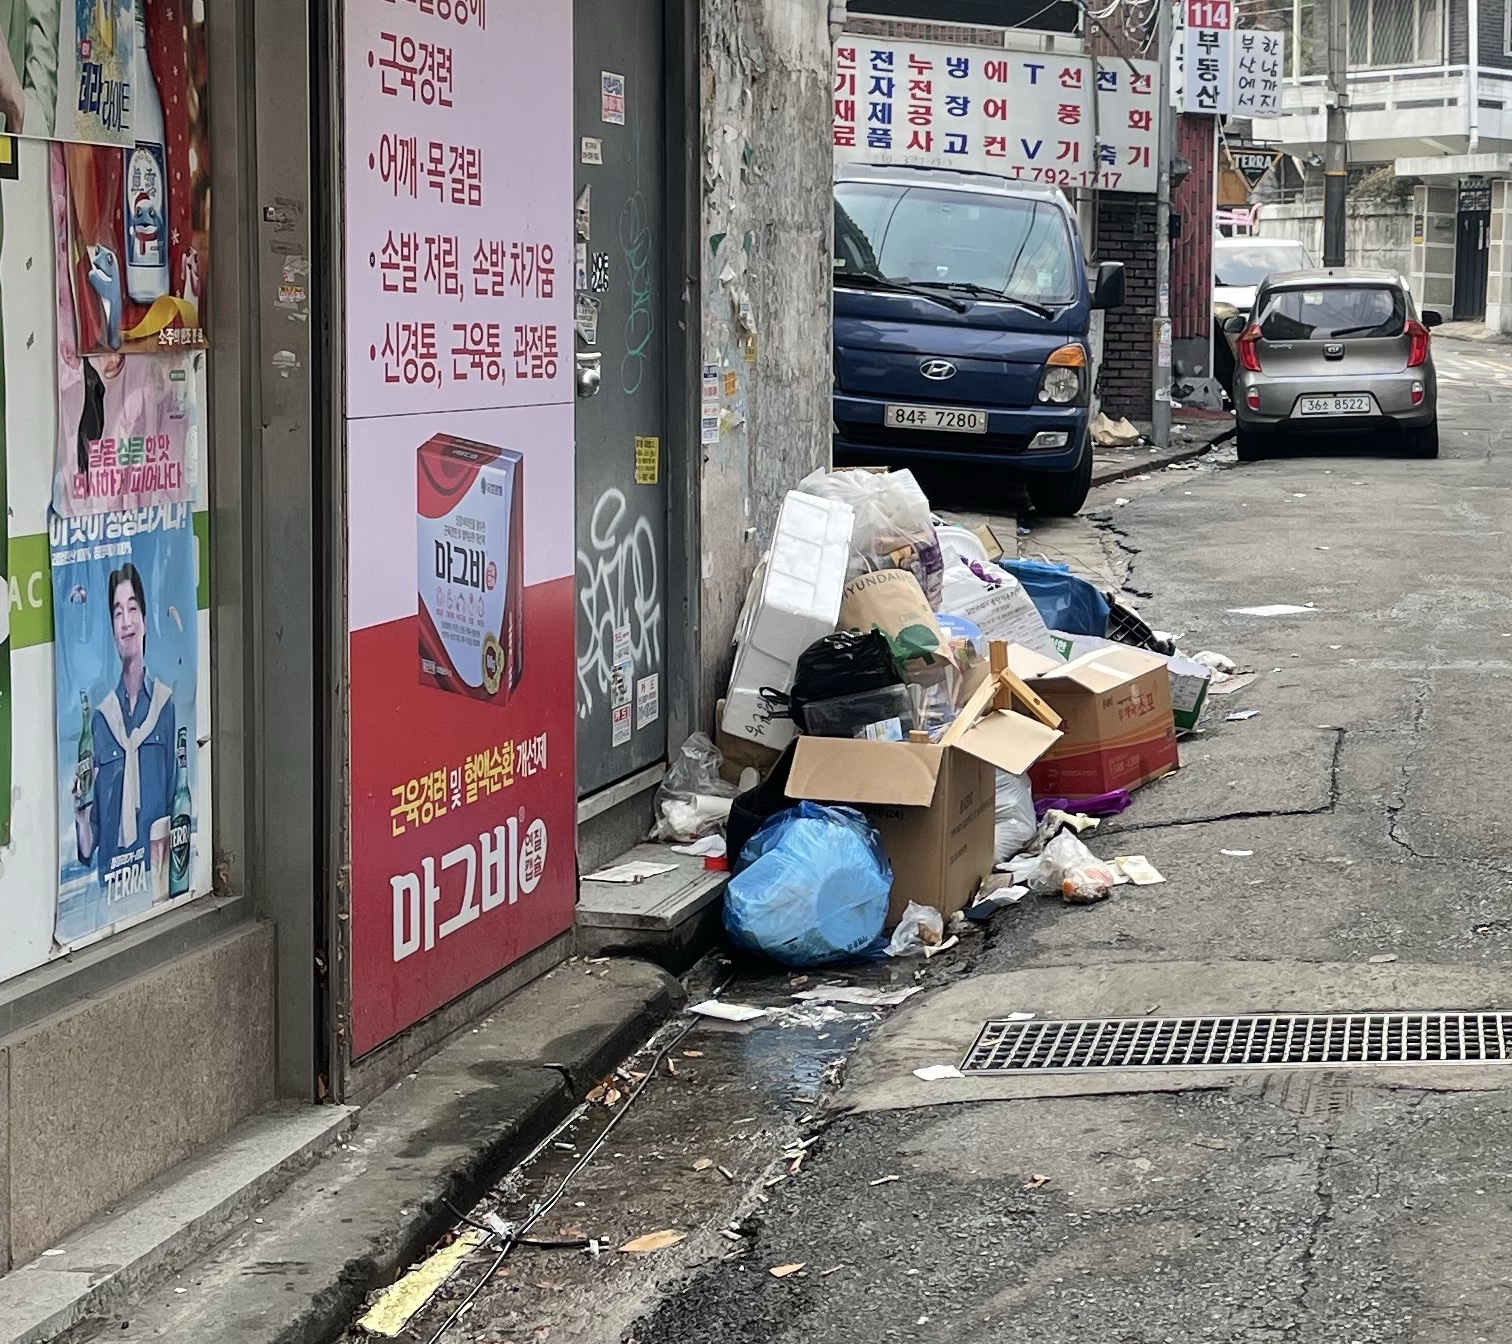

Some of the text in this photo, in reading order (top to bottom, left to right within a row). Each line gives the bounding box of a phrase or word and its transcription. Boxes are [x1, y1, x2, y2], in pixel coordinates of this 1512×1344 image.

[1191, 3, 1228, 27] 114
[379, 32, 453, 108] 근육경련
[833, 47, 856, 147] 전기재료
[867, 49, 895, 149] 전자제품
[906, 53, 933, 152] 누전공사
[943, 56, 970, 155] 냉장고
[1196, 31, 1220, 109] 부동산
[1239, 35, 1256, 107] 부산에서
[1260, 36, 1279, 108] 한남까지
[983, 60, 1008, 157] 에어컨
[1020, 63, 1045, 159] TV
[1056, 67, 1082, 162] 선풍기
[1127, 73, 1152, 168] 전화기
[448, 145, 482, 206] 결림
[1032, 167, 1122, 190] 792-1717
[1233, 155, 1273, 169] TERRA
[380, 230, 419, 293] 손발
[424, 234, 464, 302] 저림,
[472, 238, 506, 298] 손발
[509, 242, 555, 298] 차가움
[381, 322, 559, 389] 신경통, 근육통, 관절통
[895, 408, 977, 428] 84주 7280
[1307, 399, 1363, 411] 36소 8522
[434, 539, 486, 593] 마그비
[390, 732, 548, 837] 근육경련 및 혈액순환 개선제
[104, 860, 148, 906] TERRA
[390, 816, 518, 963] 마그비
